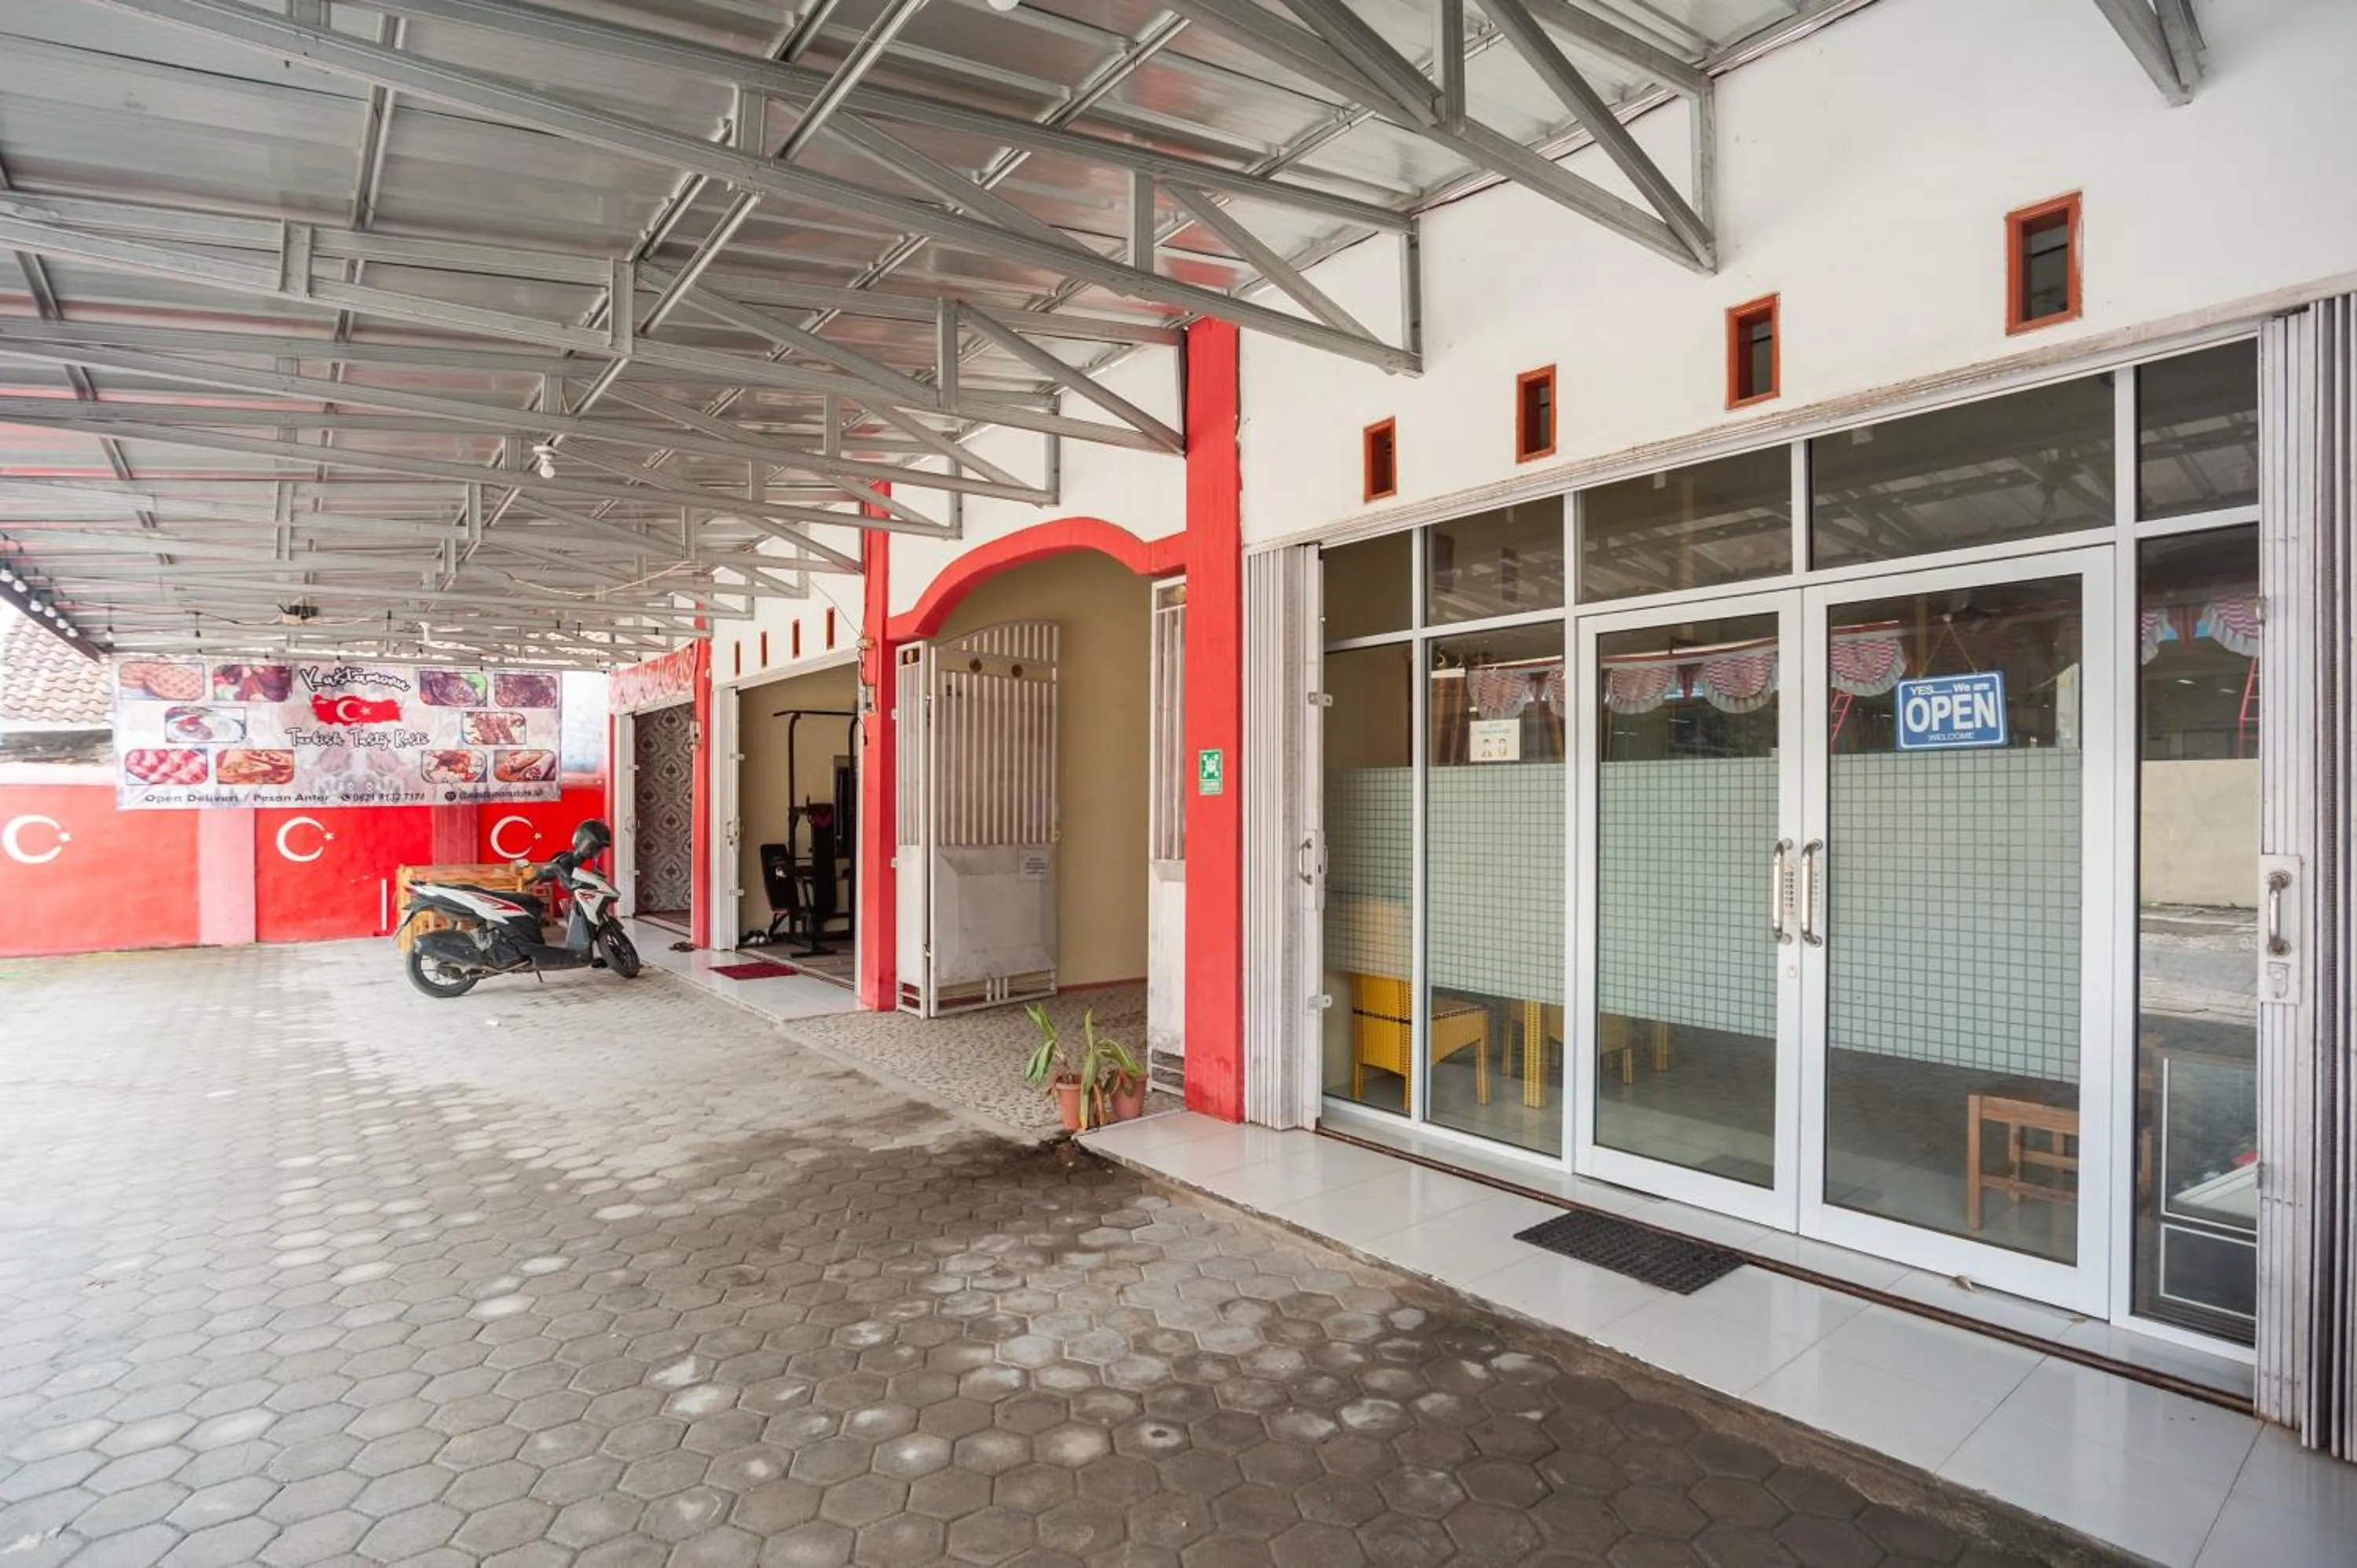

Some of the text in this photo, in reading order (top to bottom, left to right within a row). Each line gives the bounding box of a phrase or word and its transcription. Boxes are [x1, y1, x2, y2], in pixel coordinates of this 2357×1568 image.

[1905, 691, 1997, 733] OPEN
[1927, 731, 1975, 742] WELCOME
[145, 793, 182, 804] Open
[254, 793, 291, 803] Pesan
[295, 793, 329, 802] Antar
